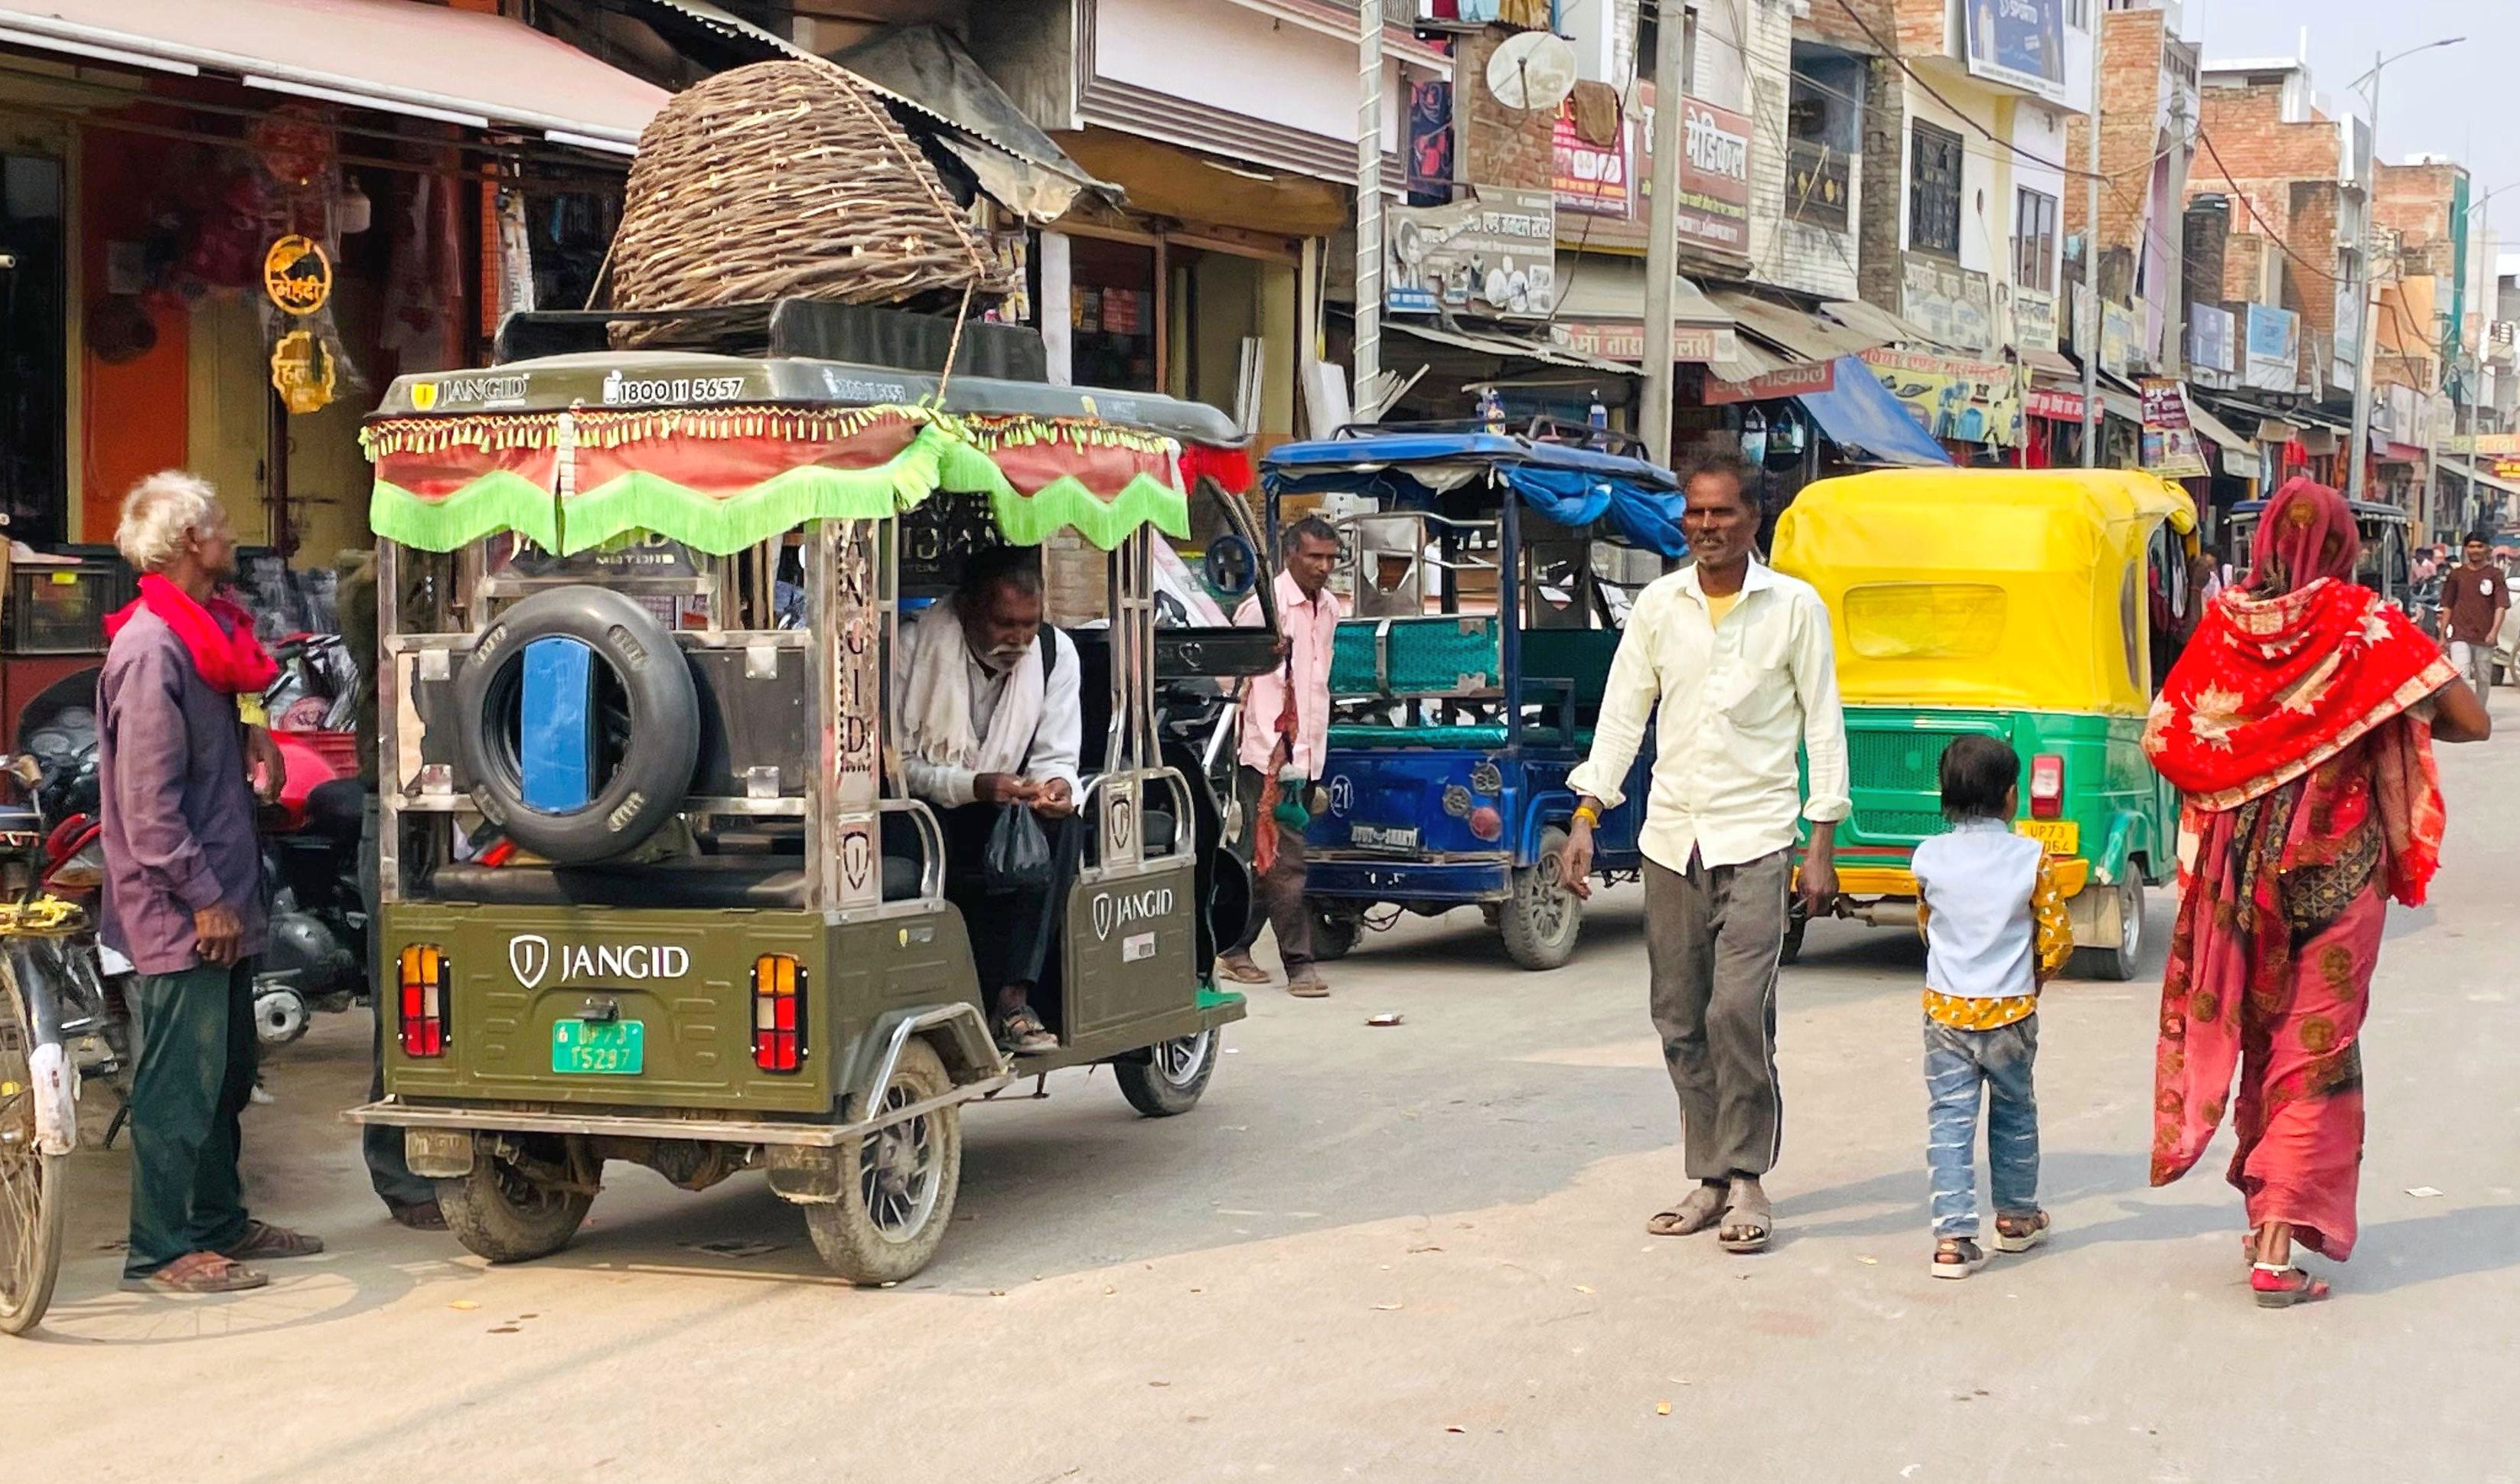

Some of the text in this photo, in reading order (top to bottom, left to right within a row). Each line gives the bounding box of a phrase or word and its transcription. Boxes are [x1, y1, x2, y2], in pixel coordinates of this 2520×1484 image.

[440, 376, 528, 408] JANGID
[621, 380, 742, 402] 1800 11 5657
[1332, 782, 1350, 810] 21
[1117, 889, 1173, 929] JANGID
[561, 944, 689, 982] JANGID
